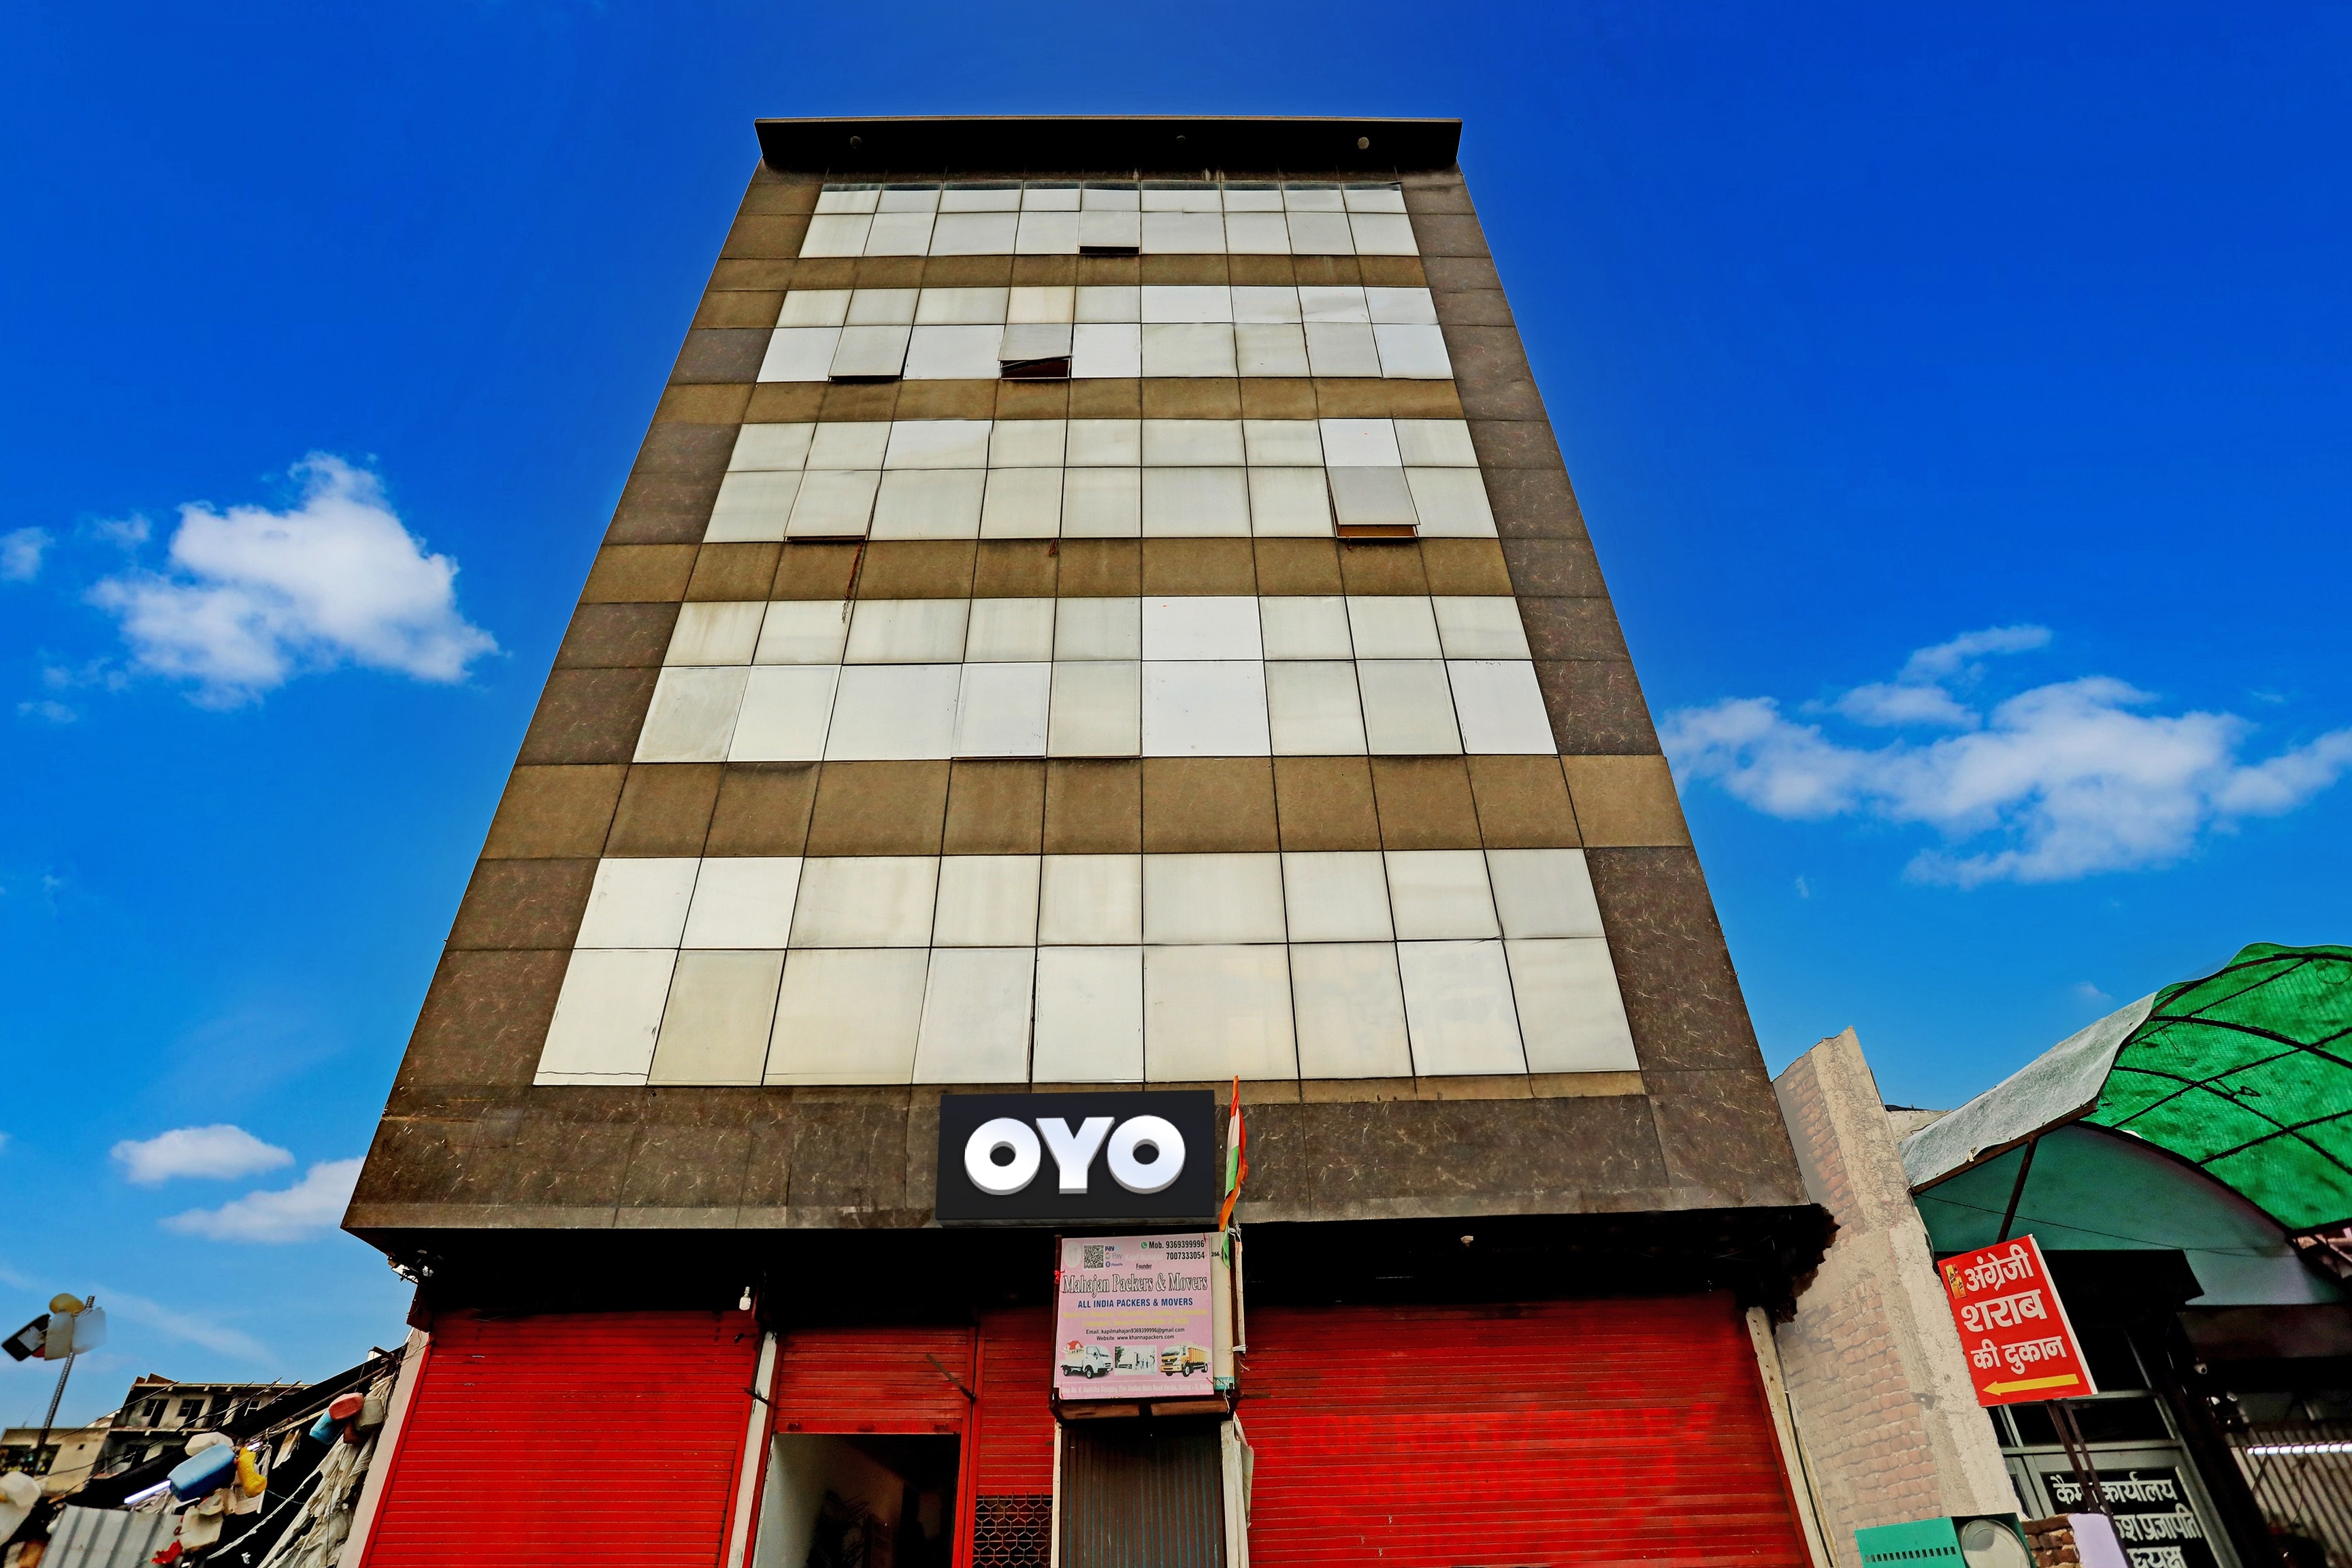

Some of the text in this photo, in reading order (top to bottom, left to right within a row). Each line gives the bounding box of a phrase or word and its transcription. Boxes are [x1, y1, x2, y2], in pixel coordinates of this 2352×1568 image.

[964, 1115, 1186, 1196] OYO
[1149, 1240, 1205, 1250] Mob. 9369399996
[1166, 1252, 1205, 1260] 7007333054
[1963, 1244, 2034, 1292] अंग्रेजी
[1063, 1272, 1208, 1298] Mahajan Packers & Movers
[1077, 1297, 1193, 1308] ALL INDIA PACKERS & MOVERS
[1961, 1288, 2048, 1333] शराब
[1970, 1335, 2068, 1375] की दुकान
[2100, 1471, 2178, 1503] कार्यालय
